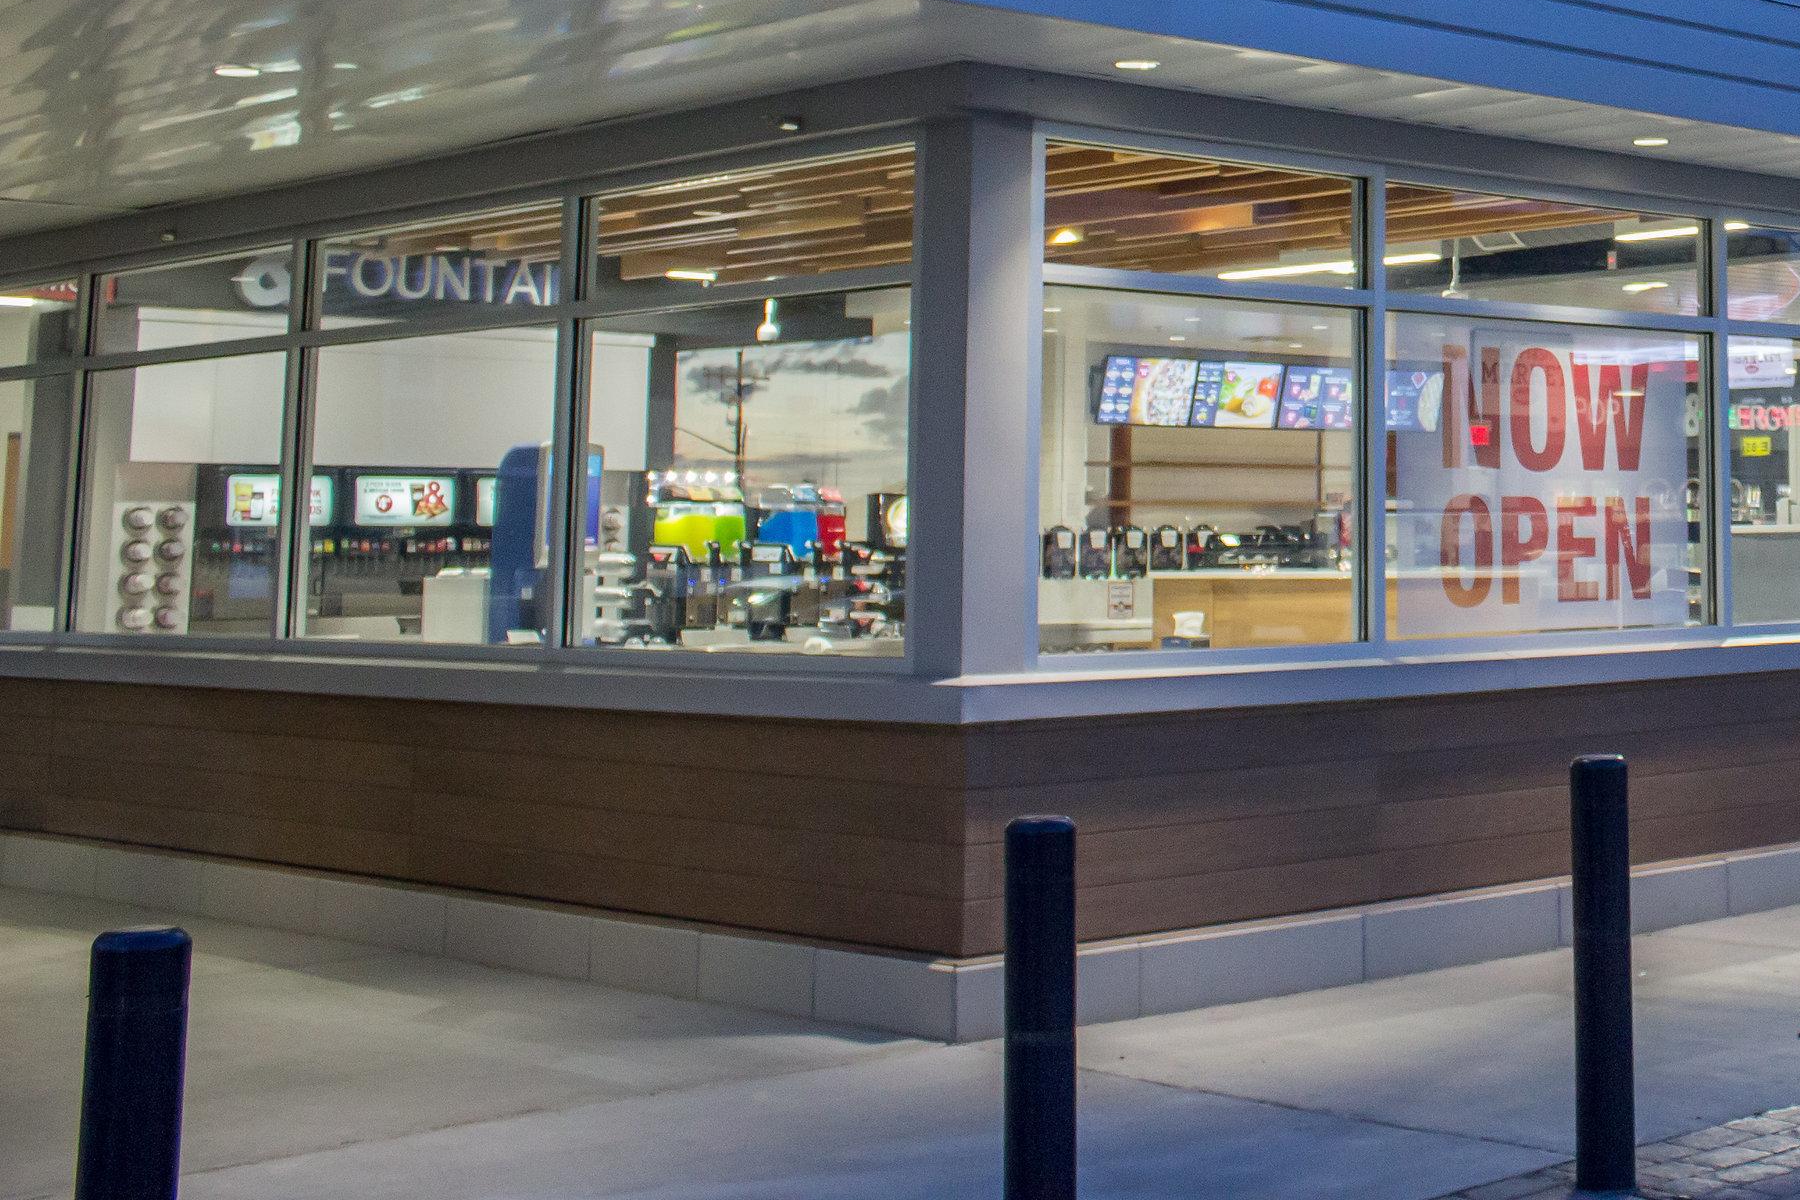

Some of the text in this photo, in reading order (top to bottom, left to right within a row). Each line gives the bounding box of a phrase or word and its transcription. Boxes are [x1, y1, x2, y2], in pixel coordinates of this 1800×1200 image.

[319, 251, 554, 306] FOUNTAI
[1441, 343, 1649, 473] NOW
[1439, 493, 1651, 609] OPEN
